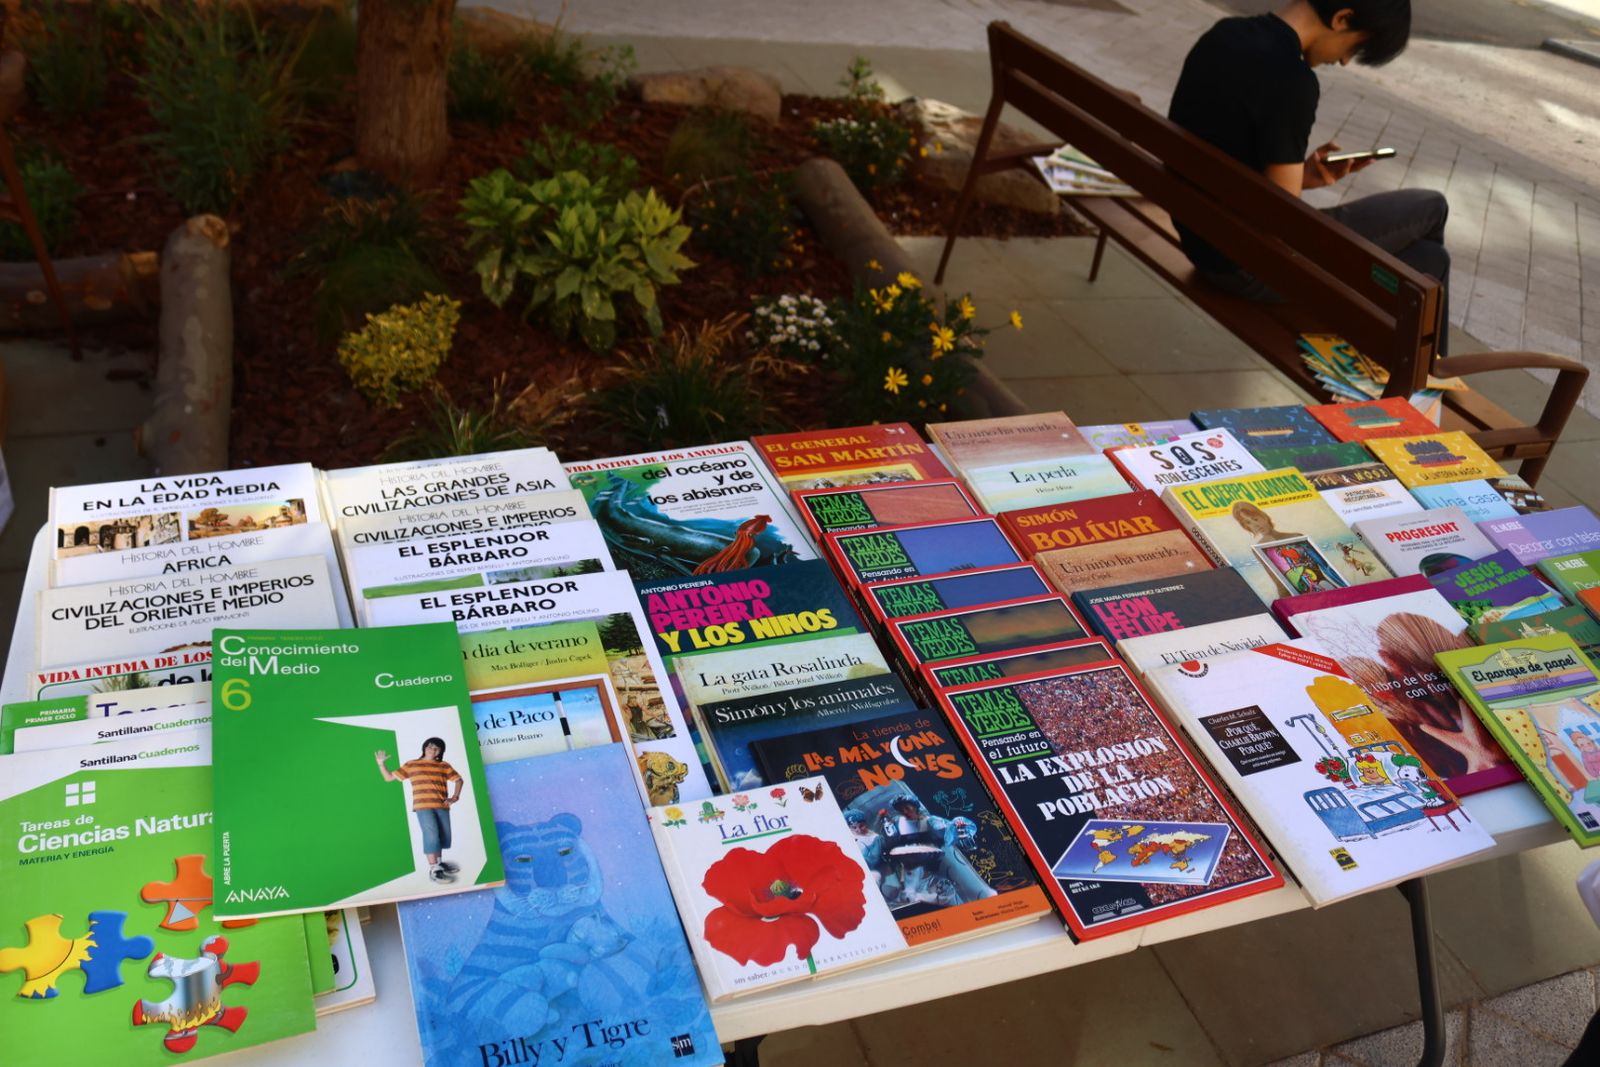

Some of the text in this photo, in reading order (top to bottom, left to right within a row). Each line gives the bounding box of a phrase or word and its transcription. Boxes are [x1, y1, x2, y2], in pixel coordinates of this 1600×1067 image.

[765, 436, 871, 452] EL GENERAL
[775, 443, 924, 468] SAN MARTÍN
[565, 445, 745, 474] VIDA INTIMA DE LOS ANIMALES
[642, 459, 747, 480] del océano
[713, 469, 754, 486] y de
[1009, 465, 1077, 483] La perla
[1155, 459, 1243, 485] ADOLESCENTES
[140, 476, 223, 493] LA VIDA
[381, 473, 510, 499] LAS GRANDES
[648, 494, 679, 506] los
[683, 481, 763, 502] abismos
[83, 500, 112, 511] EN
[119, 496, 149, 508] LA
[153, 489, 210, 504] EDAD
[216, 482, 280, 497] MEDIA
[342, 478, 556, 517] CIVILIZACIONES DE ASIA
[808, 493, 863, 511] TEMAS
[1182, 482, 1256, 511] EL CUERPO
[1468, 493, 1501, 505] casa
[354, 518, 485, 544] CIVILIZACIONES
[489, 516, 499, 526] E
[503, 507, 577, 525] IMPERIOS
[816, 507, 873, 524] VERDES
[1016, 509, 1078, 528] SIMÓN
[398, 546, 423, 557] EL
[428, 530, 550, 553] ESPLENDOR
[841, 533, 898, 551] TEMAS
[1027, 515, 1162, 550] BOLÍVAR
[1384, 521, 1460, 543] PROGRESINT
[1508, 540, 1554, 554] Decorar
[1555, 536, 1579, 547] con
[162, 555, 232, 574] AFRICA
[429, 547, 529, 568] BÁRBARO
[850, 549, 906, 567] VERDES
[1059, 554, 1135, 574] Un ha
[109, 568, 259, 597] HISTORIA DEL HOMBRE
[861, 567, 902, 579] Pensando
[1455, 560, 1504, 588] JESÚS
[52, 574, 315, 621] CIVILIZACIONES E IMPERIOS
[420, 581, 579, 610] EL ESPLENDOR
[641, 580, 714, 595] ANTONIO PEREIRA
[648, 579, 772, 614] ANTONIO
[877, 583, 939, 602] TEMAS
[85, 591, 284, 631] DEL ORIENTE MEDIO
[452, 599, 556, 621] BÁRBARO
[650, 599, 774, 634] PEREIRA
[1091, 597, 1158, 623] LEON
[904, 618, 964, 641] TEMAS
[1103, 611, 1185, 640] FELIPE
[219, 635, 360, 656] Conocimiento
[504, 636, 588, 654] de verano
[659, 622, 745, 653] Y LOS
[913, 635, 976, 659] VERDES
[1160, 635, 1268, 665] El Tren de Navidad
[38, 650, 213, 686] VIDA INTIMA DE LOS
[220, 655, 321, 676] del Medio
[699, 653, 863, 687] La gata Rosalinda
[940, 664, 1000, 684] TEMAS
[1472, 654, 1577, 682] El parque de papel
[374, 672, 454, 689] Cuaderno
[1371, 680, 1401, 692] libro
[1403, 676, 1418, 686] de
[1418, 672, 1438, 683] los
[221, 678, 252, 711] 6
[715, 682, 895, 723] Simón los animales
[955, 688, 1019, 714] TEMAS
[1406, 687, 1428, 699] con
[483, 714, 506, 730] de
[508, 710, 555, 726] Paco
[852, 719, 931, 741] La tienda de
[966, 706, 1032, 733] VERDES
[899, 730, 945, 752] UNA
[981, 731, 1041, 748] Pensando en
[989, 741, 1049, 760] el futuro
[998, 735, 1169, 784] LA EXPLOSIÓN
[1061, 764, 1136, 794] DE LA
[1037, 774, 1176, 821] POBLACIÓN
[20, 814, 94, 833] Tareas de
[718, 813, 790, 840] La flor
[18, 823, 130, 854] Ciencias
[19, 845, 115, 866] MATERIA ENERGÍA
[224, 885, 290, 904] ANAYA
[902, 919, 941, 937] Combel
[478, 1018, 651, 1067] Billy y Tigre
